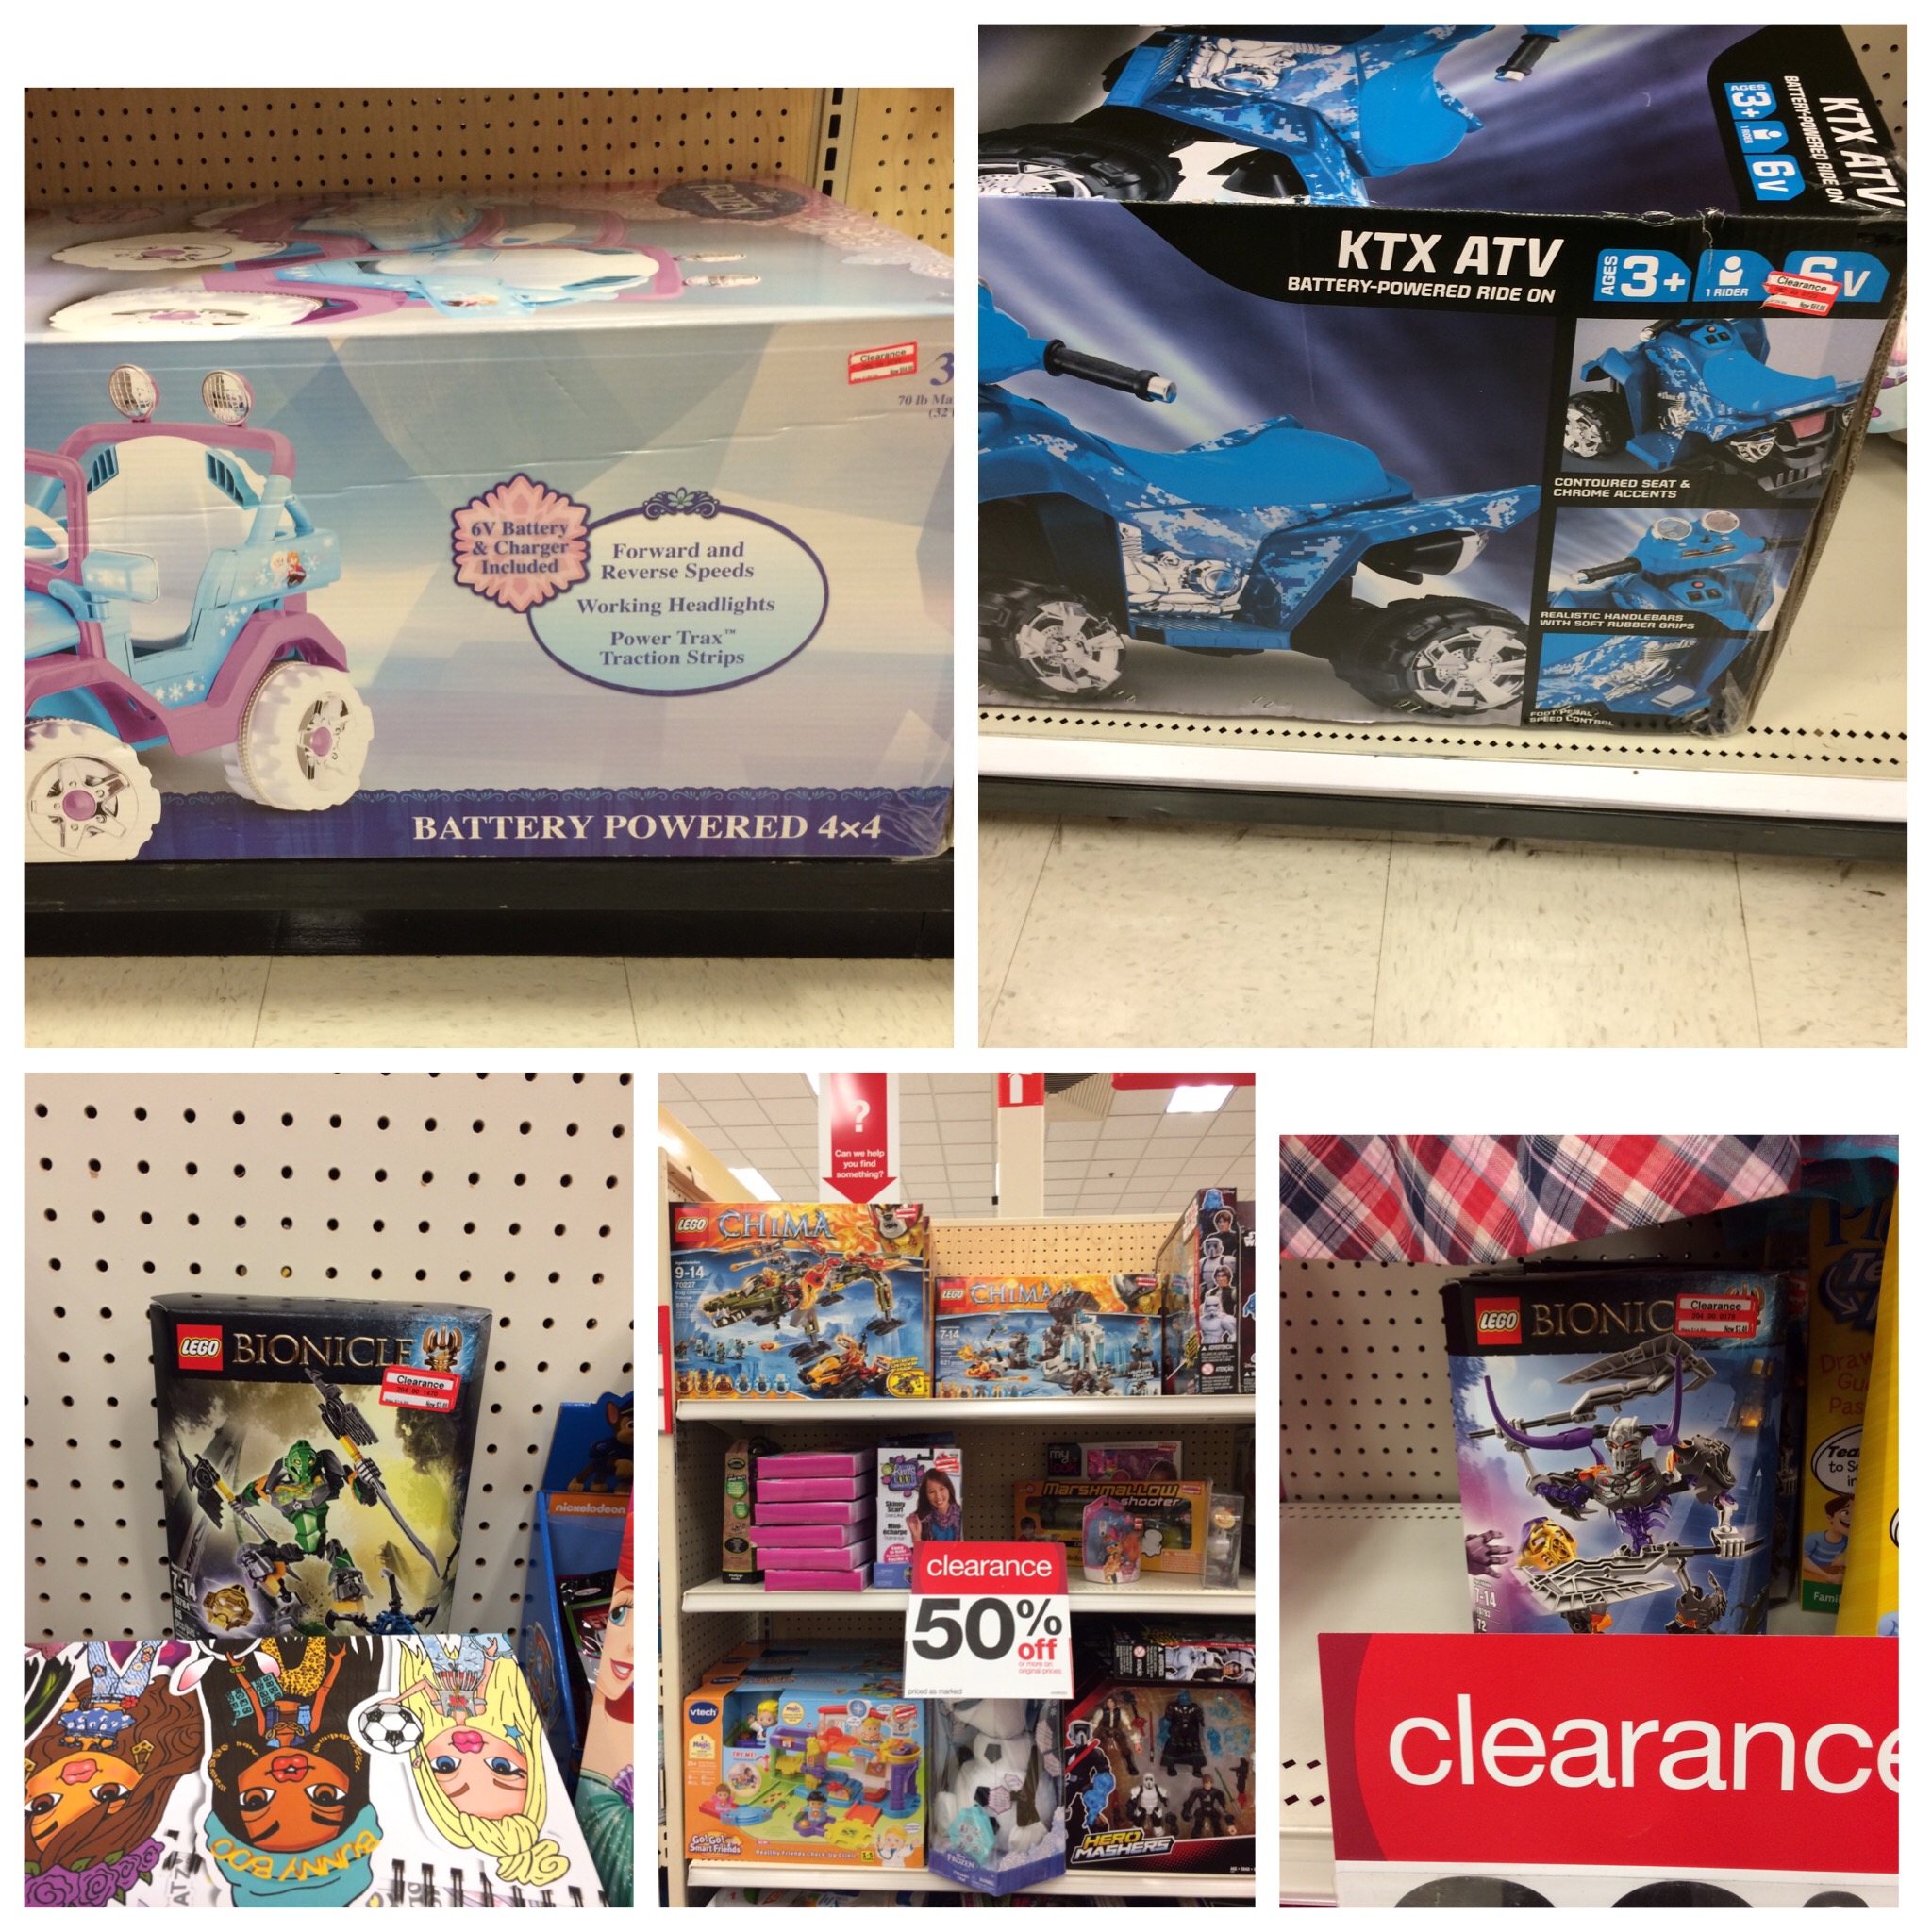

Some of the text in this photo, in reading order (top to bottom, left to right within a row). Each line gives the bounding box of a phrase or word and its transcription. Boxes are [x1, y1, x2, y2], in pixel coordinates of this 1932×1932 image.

[1731, 92, 1772, 118] 3+
[1784, 75, 1846, 204] BATTERY-POWERED RIDE ON
[1819, 97, 1906, 208] KTX ATV
[1752, 160, 1796, 192] 6V
[1337, 230, 1565, 278] KTX ATV
[1600, 255, 1619, 296] AGES
[1620, 254, 1687, 298] 3+
[1287, 276, 1557, 304] BATTERY-POWERED RIDE ON
[1776, 275, 1827, 292] Clearance
[1706, 287, 1749, 297] 1 RIDER
[859, 349, 907, 363] Clearance
[898, 394, 913, 406] 70
[915, 394, 928, 406] lb
[928, 407, 949, 420] (32
[1554, 477, 1690, 489] CONTOURED SEAT &
[1553, 488, 1678, 499] CHROME ACCENTS
[471, 520, 570, 540] 6V Battery
[472, 540, 569, 559] & Charger
[612, 541, 745, 561] Forward and
[480, 558, 559, 575] Included
[599, 563, 756, 583] Reverse Speeds
[576, 596, 776, 617] Working Headlights
[1540, 611, 1685, 623] REALISTIC HANDLEBARS
[1540, 619, 1696, 631] WITH SOFT RUBBER GRIPS
[609, 630, 672, 647] Power
[599, 649, 746, 669] Traction Strips
[1529, 715, 1615, 727] SPEED CONTROL
[412, 815, 591, 841] BATTERY
[602, 814, 808, 841] POWERED
[834, 1149, 885, 1160] Can we help
[843, 1159, 876, 1171] you find
[836, 1169, 885, 1180] something?
[676, 1217, 708, 1232] LEGO
[675, 1265, 706, 1279] 9-14
[941, 1288, 965, 1300] LEGO
[1690, 1299, 1742, 1311] Clearance
[1479, 1311, 1518, 1331] LEGO
[1530, 1299, 1675, 1338] BIONIC
[940, 1329, 960, 1340] 7-14
[1724, 1324, 1735, 1333] Now
[180, 1337, 221, 1357] LEGO
[232, 1332, 415, 1369] BIONICLE
[396, 1374, 445, 1390] Clearance
[425, 1400, 436, 1408] Now
[1049, 1449, 1070, 1463] my
[1827, 1445, 1861, 1459] Tea
[1829, 1461, 1843, 1474] to
[555, 1503, 626, 1515] nickelodeon
[885, 1500, 906, 1509] Skinny
[1120, 1496, 1180, 1507] shooter
[882, 1528, 908, 1537] écharpe
[926, 1554, 1053, 1578] clearance
[171, 1571, 197, 1602] 7-14
[1474, 1587, 1497, 1608] 7-14
[912, 1597, 1063, 1661] 50%
[1476, 1618, 1487, 1632] 72
[1017, 1638, 1058, 1661] off
[1018, 1666, 1062, 1675] original prices
[908, 1687, 928, 1696] priced
[690, 1707, 718, 1717] vtech
[692, 1834, 724, 1845] Go! Go!
[1082, 1830, 1141, 1850] HERO
[211, 1830, 381, 1881] BUNNY BOO
[689, 1843, 741, 1855] Smart Friends
[1074, 1840, 1172, 1860] MASHERS
[947, 1853, 975, 1869] FROZEN
